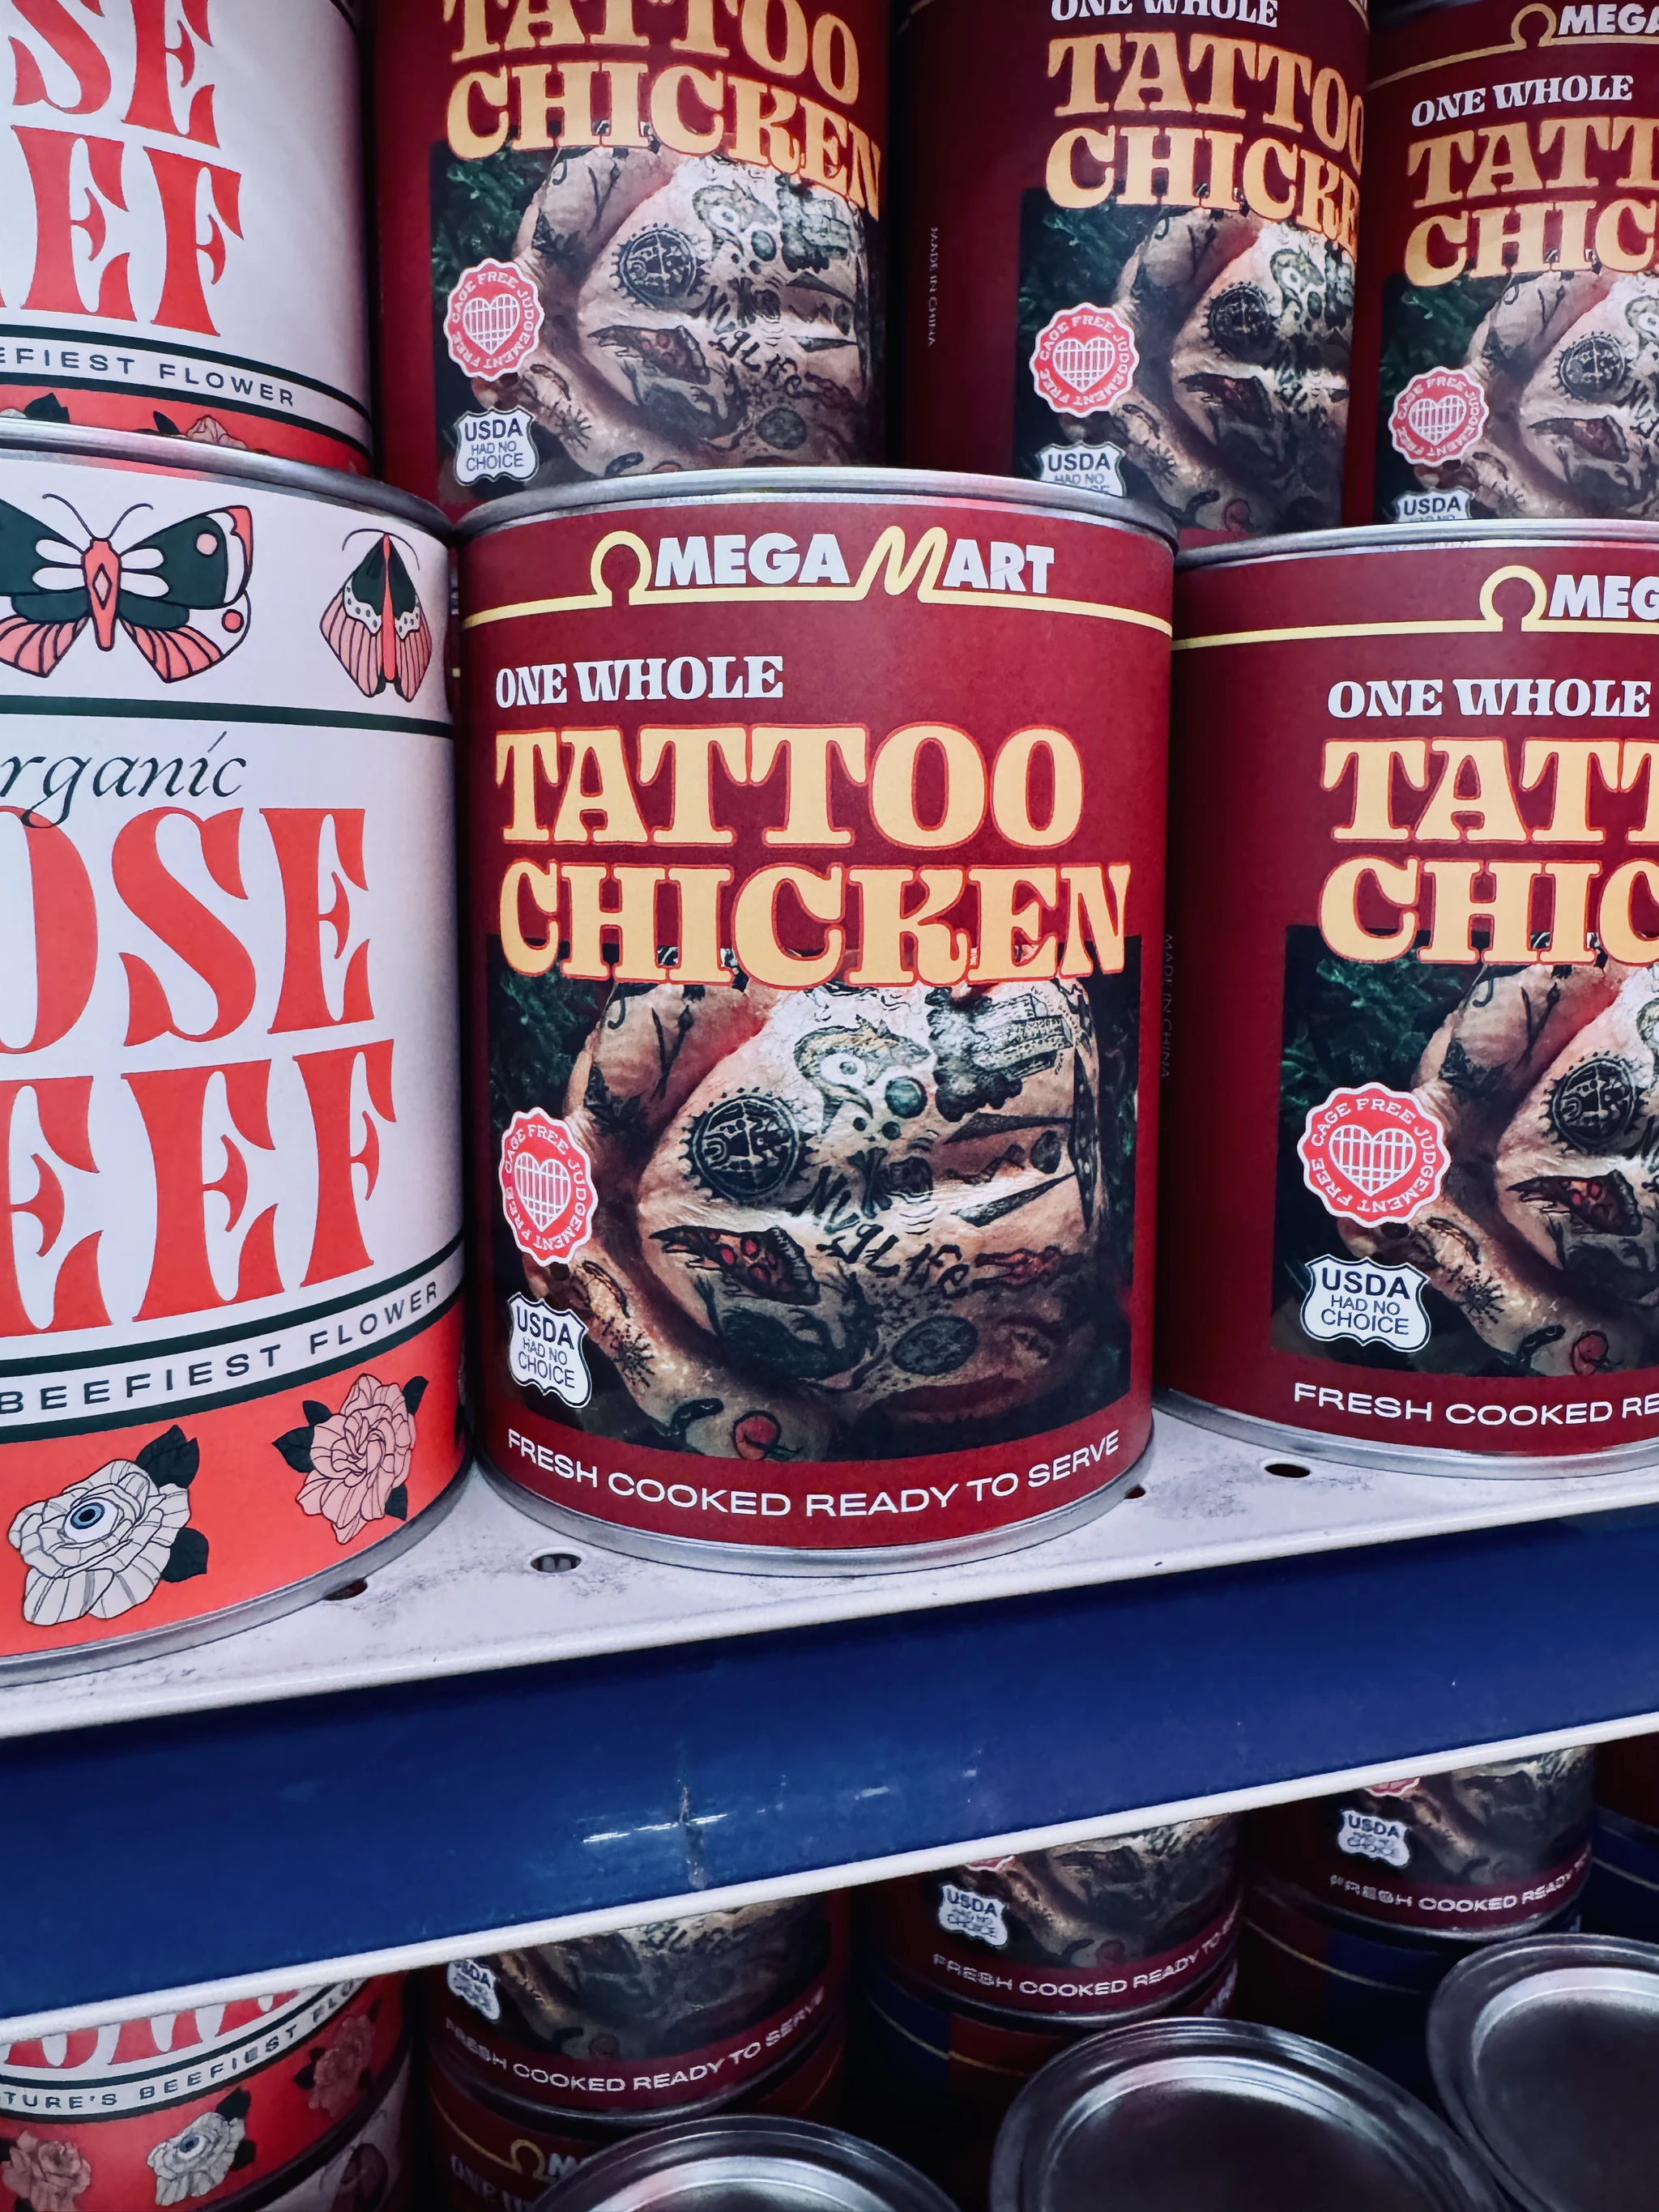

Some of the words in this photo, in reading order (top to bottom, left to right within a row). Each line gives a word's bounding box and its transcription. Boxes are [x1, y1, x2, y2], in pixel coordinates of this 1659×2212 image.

[443, 0, 859, 105] TATTOO
[1047, 32, 1364, 177] TATTOO
[1411, 87, 1486, 127] ONE
[1492, 75, 1634, 110] WHOLE
[446, 61, 881, 223] CHICKEN
[0, 125, 243, 337] EF
[1404, 198, 1659, 288] CHIC
[476, 271, 518, 289] FREE
[1071, 314, 1115, 334] FREE
[0, 347, 134, 374] FIEST
[160, 363, 293, 407] FLOWER
[464, 417, 523, 441] USDA
[471, 441, 496, 456] HAD
[498, 440, 517, 453] NO
[465, 453, 524, 471] CHOICE
[1048, 452, 1111, 472] USDA
[1054, 474, 1081, 484] HAD
[1085, 473, 1105, 484] NO
[1404, 496, 1461, 516] USDA
[855, 525, 1056, 604] MART
[496, 663, 568, 709] ONE
[573, 654, 784, 704] WHOLE
[1327, 679, 1443, 719] ONE
[1454, 678, 1651, 718] WHOLE
[495, 722, 1084, 850] TATTOO
[498, 859, 1132, 989] CHICKEN
[1161, 1018, 1172, 1078] CHINA
[1311, 1102, 1351, 1147] CAGE
[1355, 1097, 1416, 1125] FREE
[505, 1127, 527, 1174] CAGE
[527, 1123, 569, 1155] FREE
[1311, 1157, 1353, 1206] FREE
[1357, 1126, 1436, 1213] JUDGEMENT
[532, 1158, 586, 1251] JUDGEMENT
[1322, 1267, 1410, 1300] USDA
[1331, 1294, 1368, 1311] HAD
[1373, 1300, 1401, 1315] NO
[516, 1305, 575, 1349] USDA
[1320, 1308, 1410, 1336] CHOICE
[0, 1344, 281, 1413] BEEFIEST
[309, 1281, 437, 1355] FLOWER
[518, 1350, 575, 1388] CHOICE
[522, 1336, 545, 1358] HAD
[548, 1347, 568, 1365] NO
[1294, 1382, 1432, 1421] FRESH
[1445, 1400, 1613, 1426] COOKED
[1622, 1392, 1659, 1418] RE
[507, 1428, 598, 1488] FRESH
[608, 1471, 791, 1517] COOKED
[806, 1482, 959, 1517] READY
[966, 1473, 1019, 1502] TO
[1027, 1429, 1120, 1488] SERVE
[1348, 1814, 1400, 1838] USDA
[946, 1888, 998, 1917] USDA
[1418, 1894, 1517, 1912] COOKED
[1019, 1980, 1128, 1997] COOKED
[1132, 1948, 1200, 1988] READY
[3, 2091, 117, 2109] TURE'S
[139, 2024, 297, 2099] BEEFIEST
[513, 2063, 625, 2092] COOKED
[633, 2057, 724, 2091] READY
[728, 2041, 761, 2065] TO
